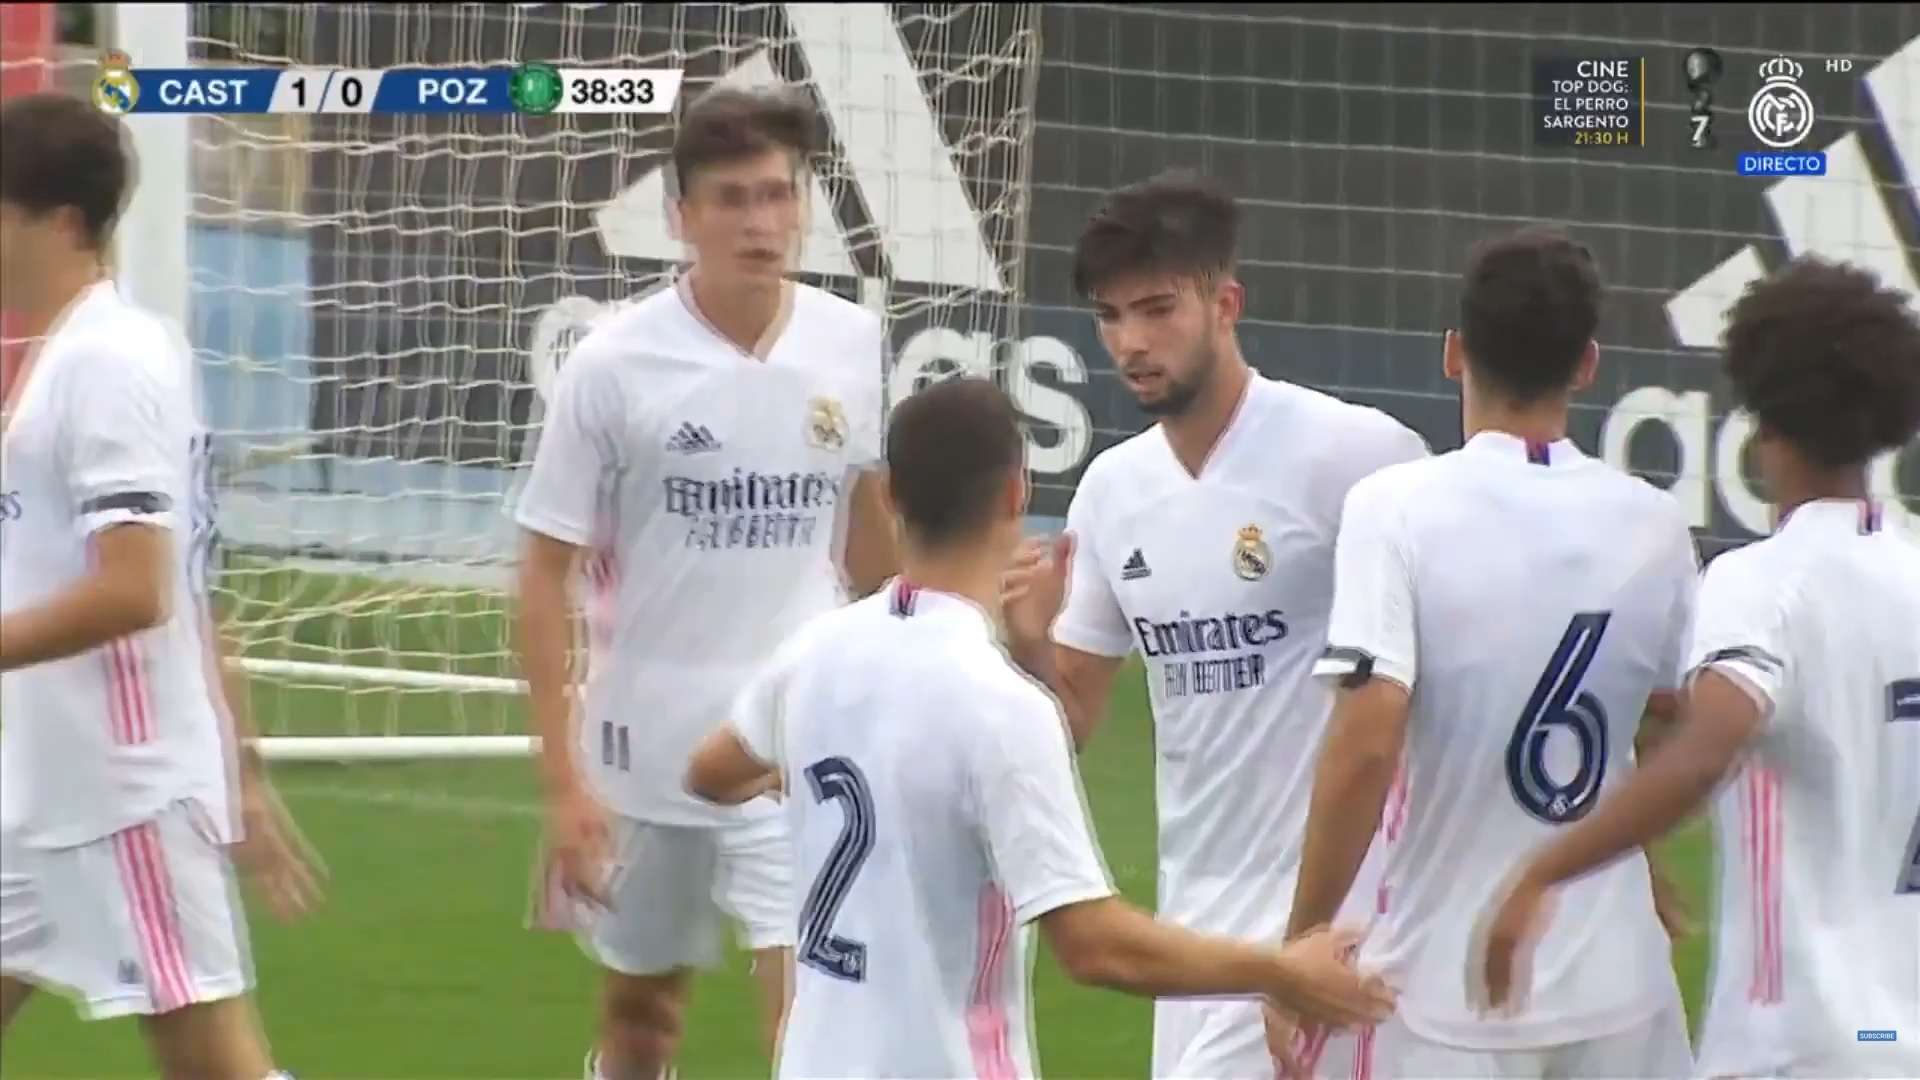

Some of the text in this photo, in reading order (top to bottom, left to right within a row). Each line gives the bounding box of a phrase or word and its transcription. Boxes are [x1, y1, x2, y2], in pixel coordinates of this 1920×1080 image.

[1134, 609, 1288, 656] Emirates
[1504, 611, 1611, 825] 6
[798, 756, 876, 982] 2
